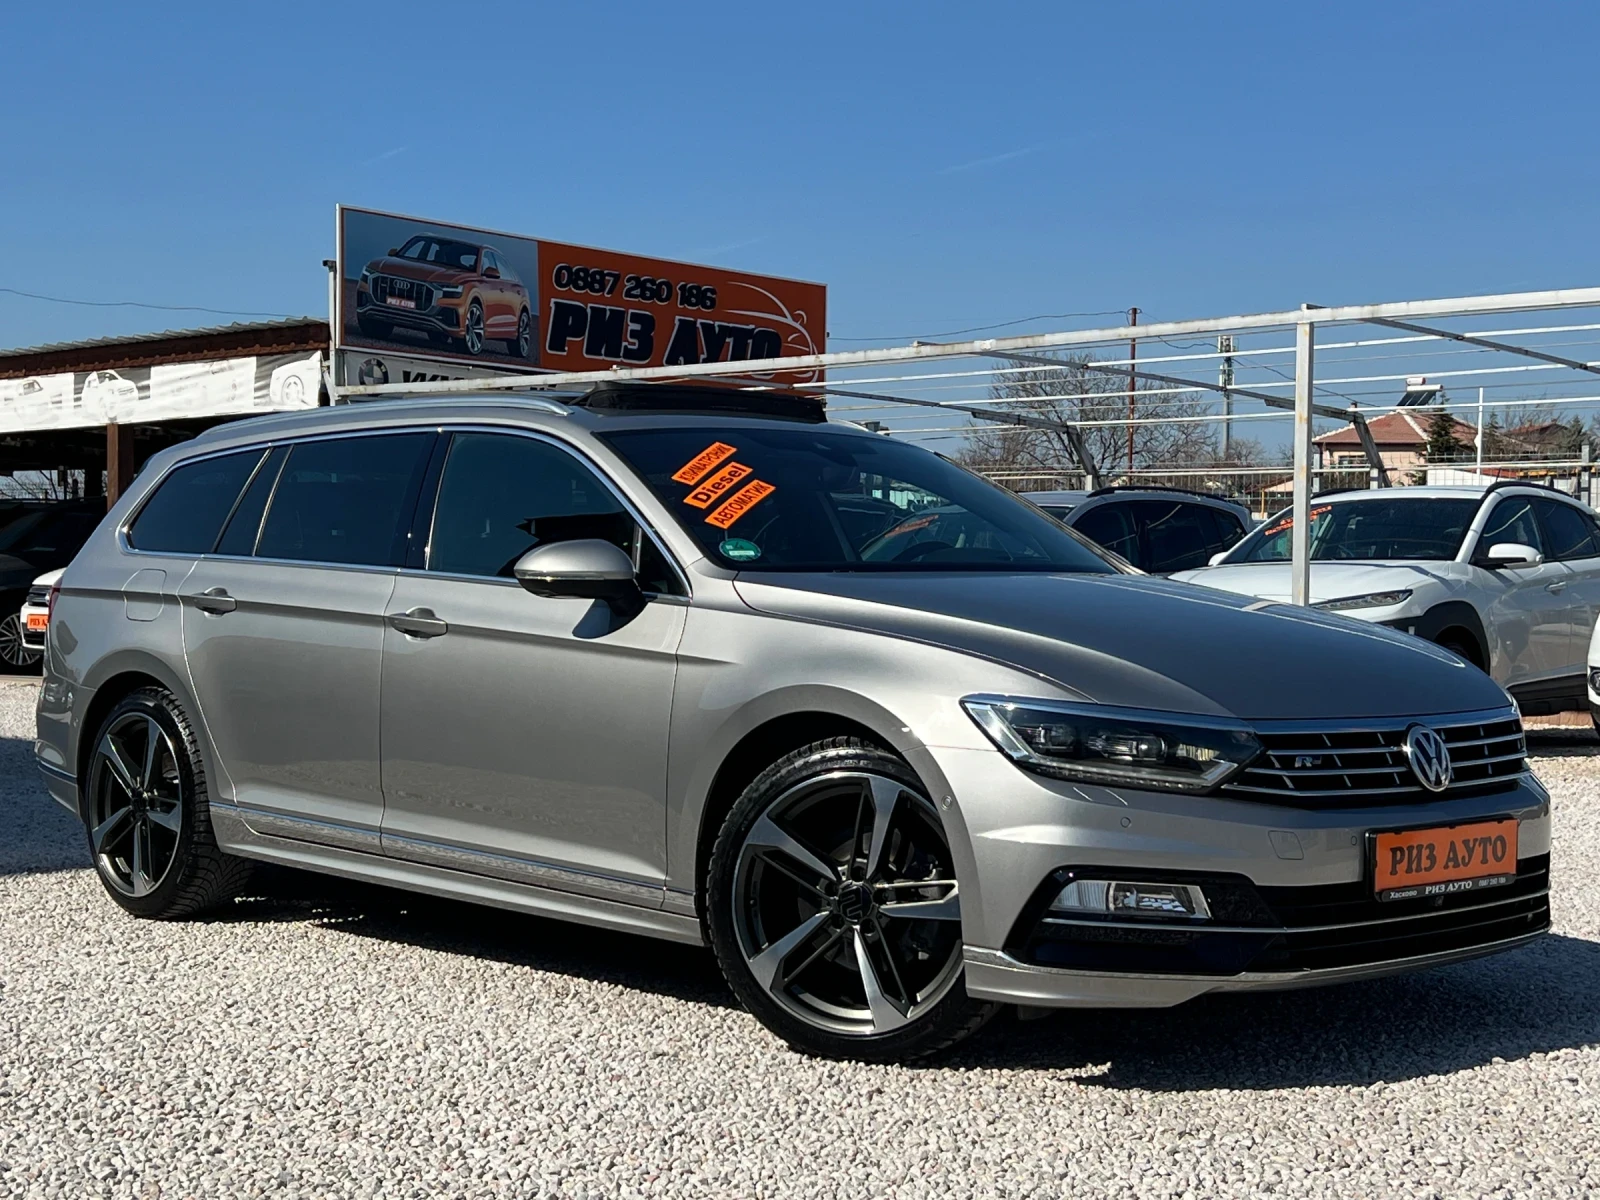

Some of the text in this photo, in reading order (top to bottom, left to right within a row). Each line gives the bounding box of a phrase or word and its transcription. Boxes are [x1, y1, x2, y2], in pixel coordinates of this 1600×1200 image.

[553, 263, 717, 311] 0887 260 186
[547, 298, 782, 373] РИЗ АУТО
[692, 465, 747, 503] Diesel
[713, 482, 771, 525] АВТОМАТИК
[1390, 835, 1507, 876] РИЗ АУТО
[1425, 884, 1445, 895] РИЗ
[1447, 881, 1472, 892] АУТО
